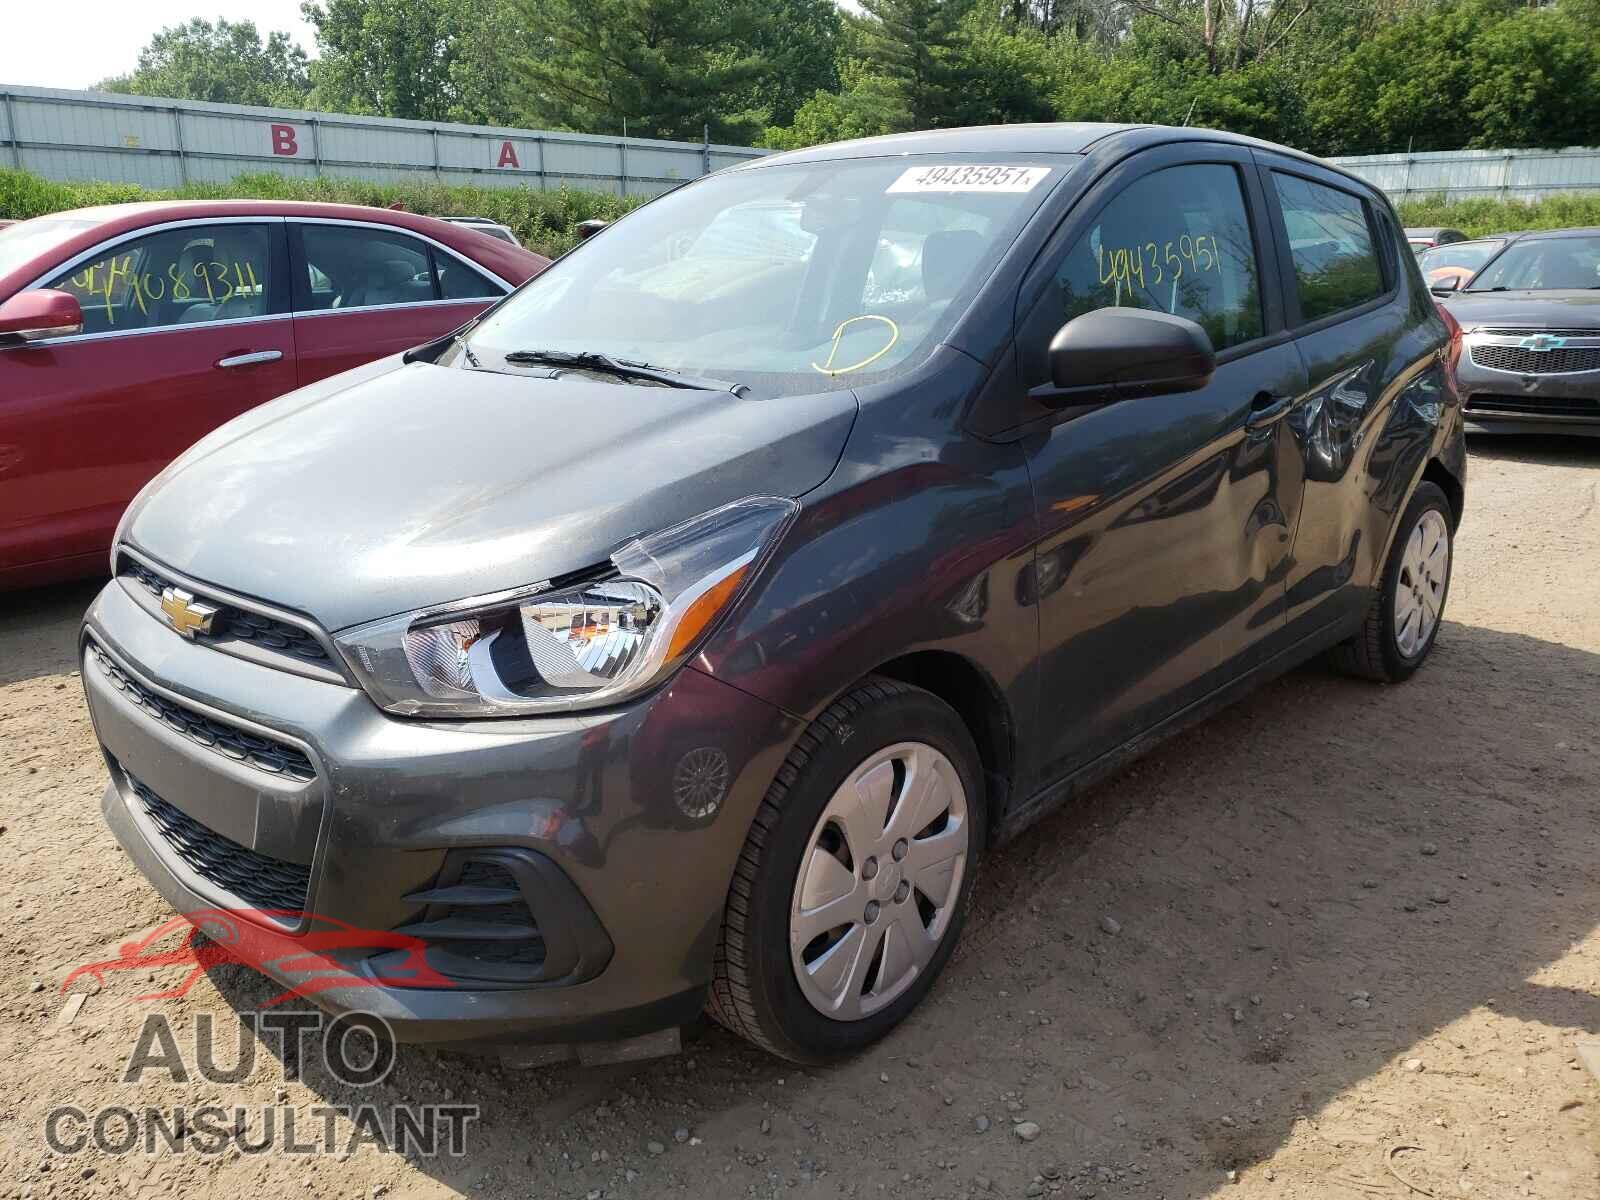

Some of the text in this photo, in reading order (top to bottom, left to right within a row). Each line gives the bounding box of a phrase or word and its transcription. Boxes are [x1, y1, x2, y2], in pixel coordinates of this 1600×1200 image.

[271, 124, 299, 156] B
[496, 140, 520, 168] A
[915, 166, 1030, 186] 49435951
[1099, 233, 1222, 297] 49435951
